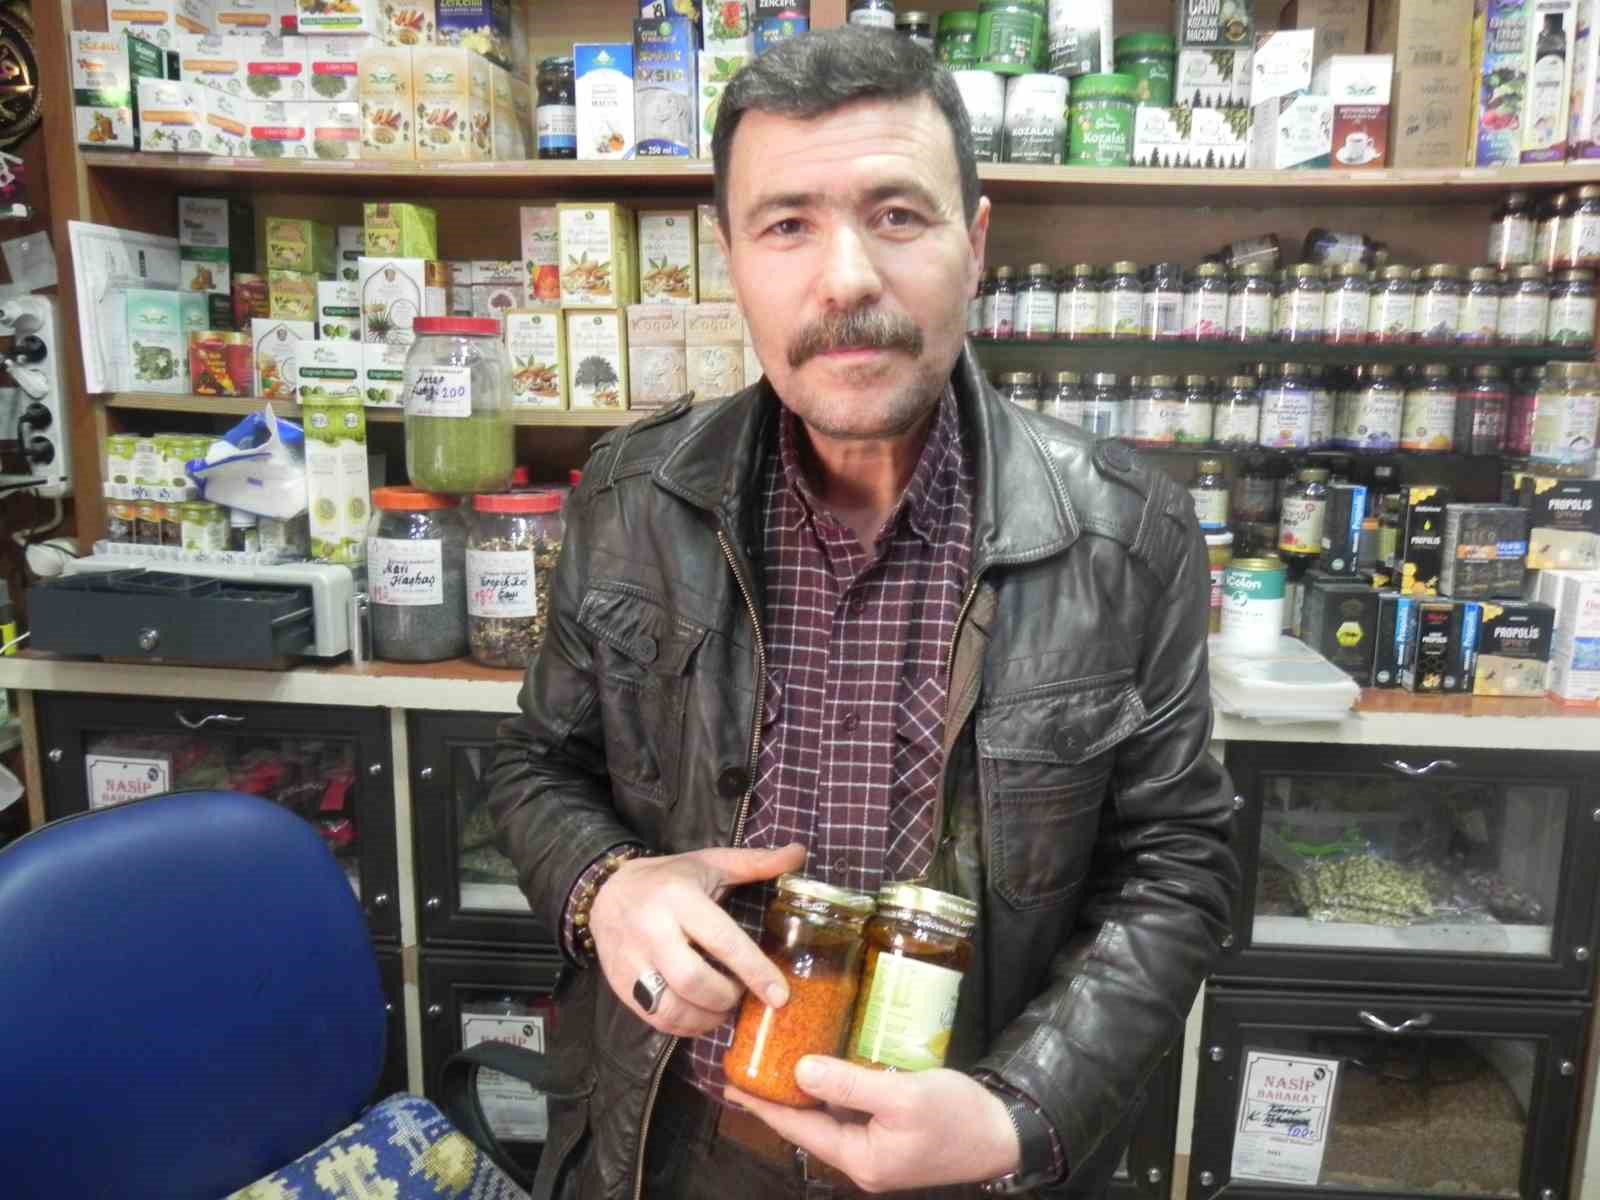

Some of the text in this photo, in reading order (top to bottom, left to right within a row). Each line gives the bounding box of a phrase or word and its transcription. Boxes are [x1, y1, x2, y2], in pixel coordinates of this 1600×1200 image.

[1012, 127, 1055, 137] KOZALAK
[1083, 131, 1127, 145] Kozalak
[105, 778, 152, 793] NASİP
[1264, 1075, 1315, 1092] NASİP
[1258, 1090, 1318, 1104] BAHARAT
